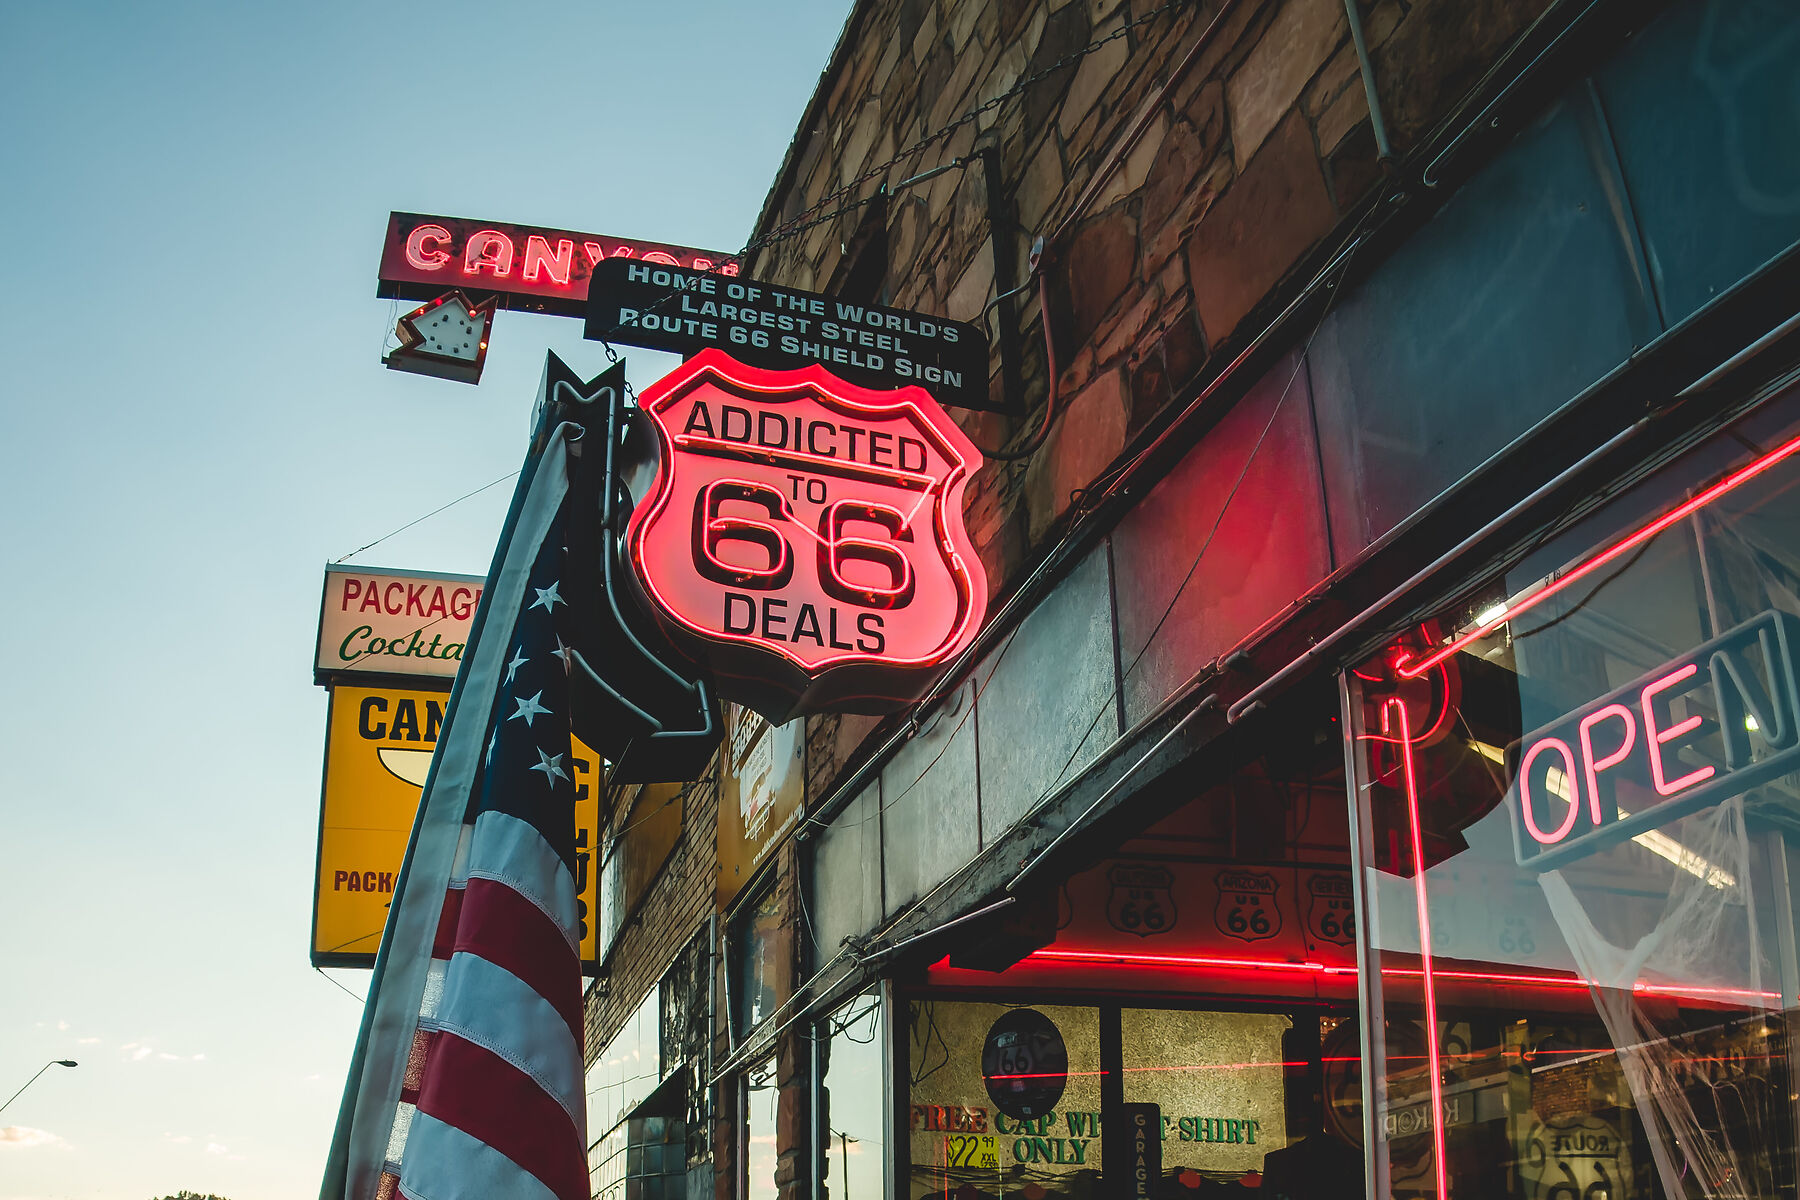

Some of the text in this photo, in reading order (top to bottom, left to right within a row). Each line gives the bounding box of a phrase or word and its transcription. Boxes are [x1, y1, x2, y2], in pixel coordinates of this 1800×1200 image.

[627, 264, 960, 344] HOME OF THE WORLD'S
[681, 295, 909, 354] LARGEST STEEL
[619, 307, 963, 389] ROUTE 66 SHIELD SIGN
[684, 400, 928, 475] ADDICTED
[786, 473, 828, 505] TO
[691, 478, 916, 611] 66
[724, 591, 886, 655] DEALS
[1519, 627, 1787, 845] OPEN
[333, 870, 400, 893] PACK
[1222, 875, 1272, 893] ARIZONA
[1121, 902, 1165, 930] 66
[1227, 908, 1271, 934] 66
[909, 1104, 989, 1133] FREE
[1013, 1137, 1091, 1165] ONLY
[1134, 1113, 1148, 1195] GARAGE
